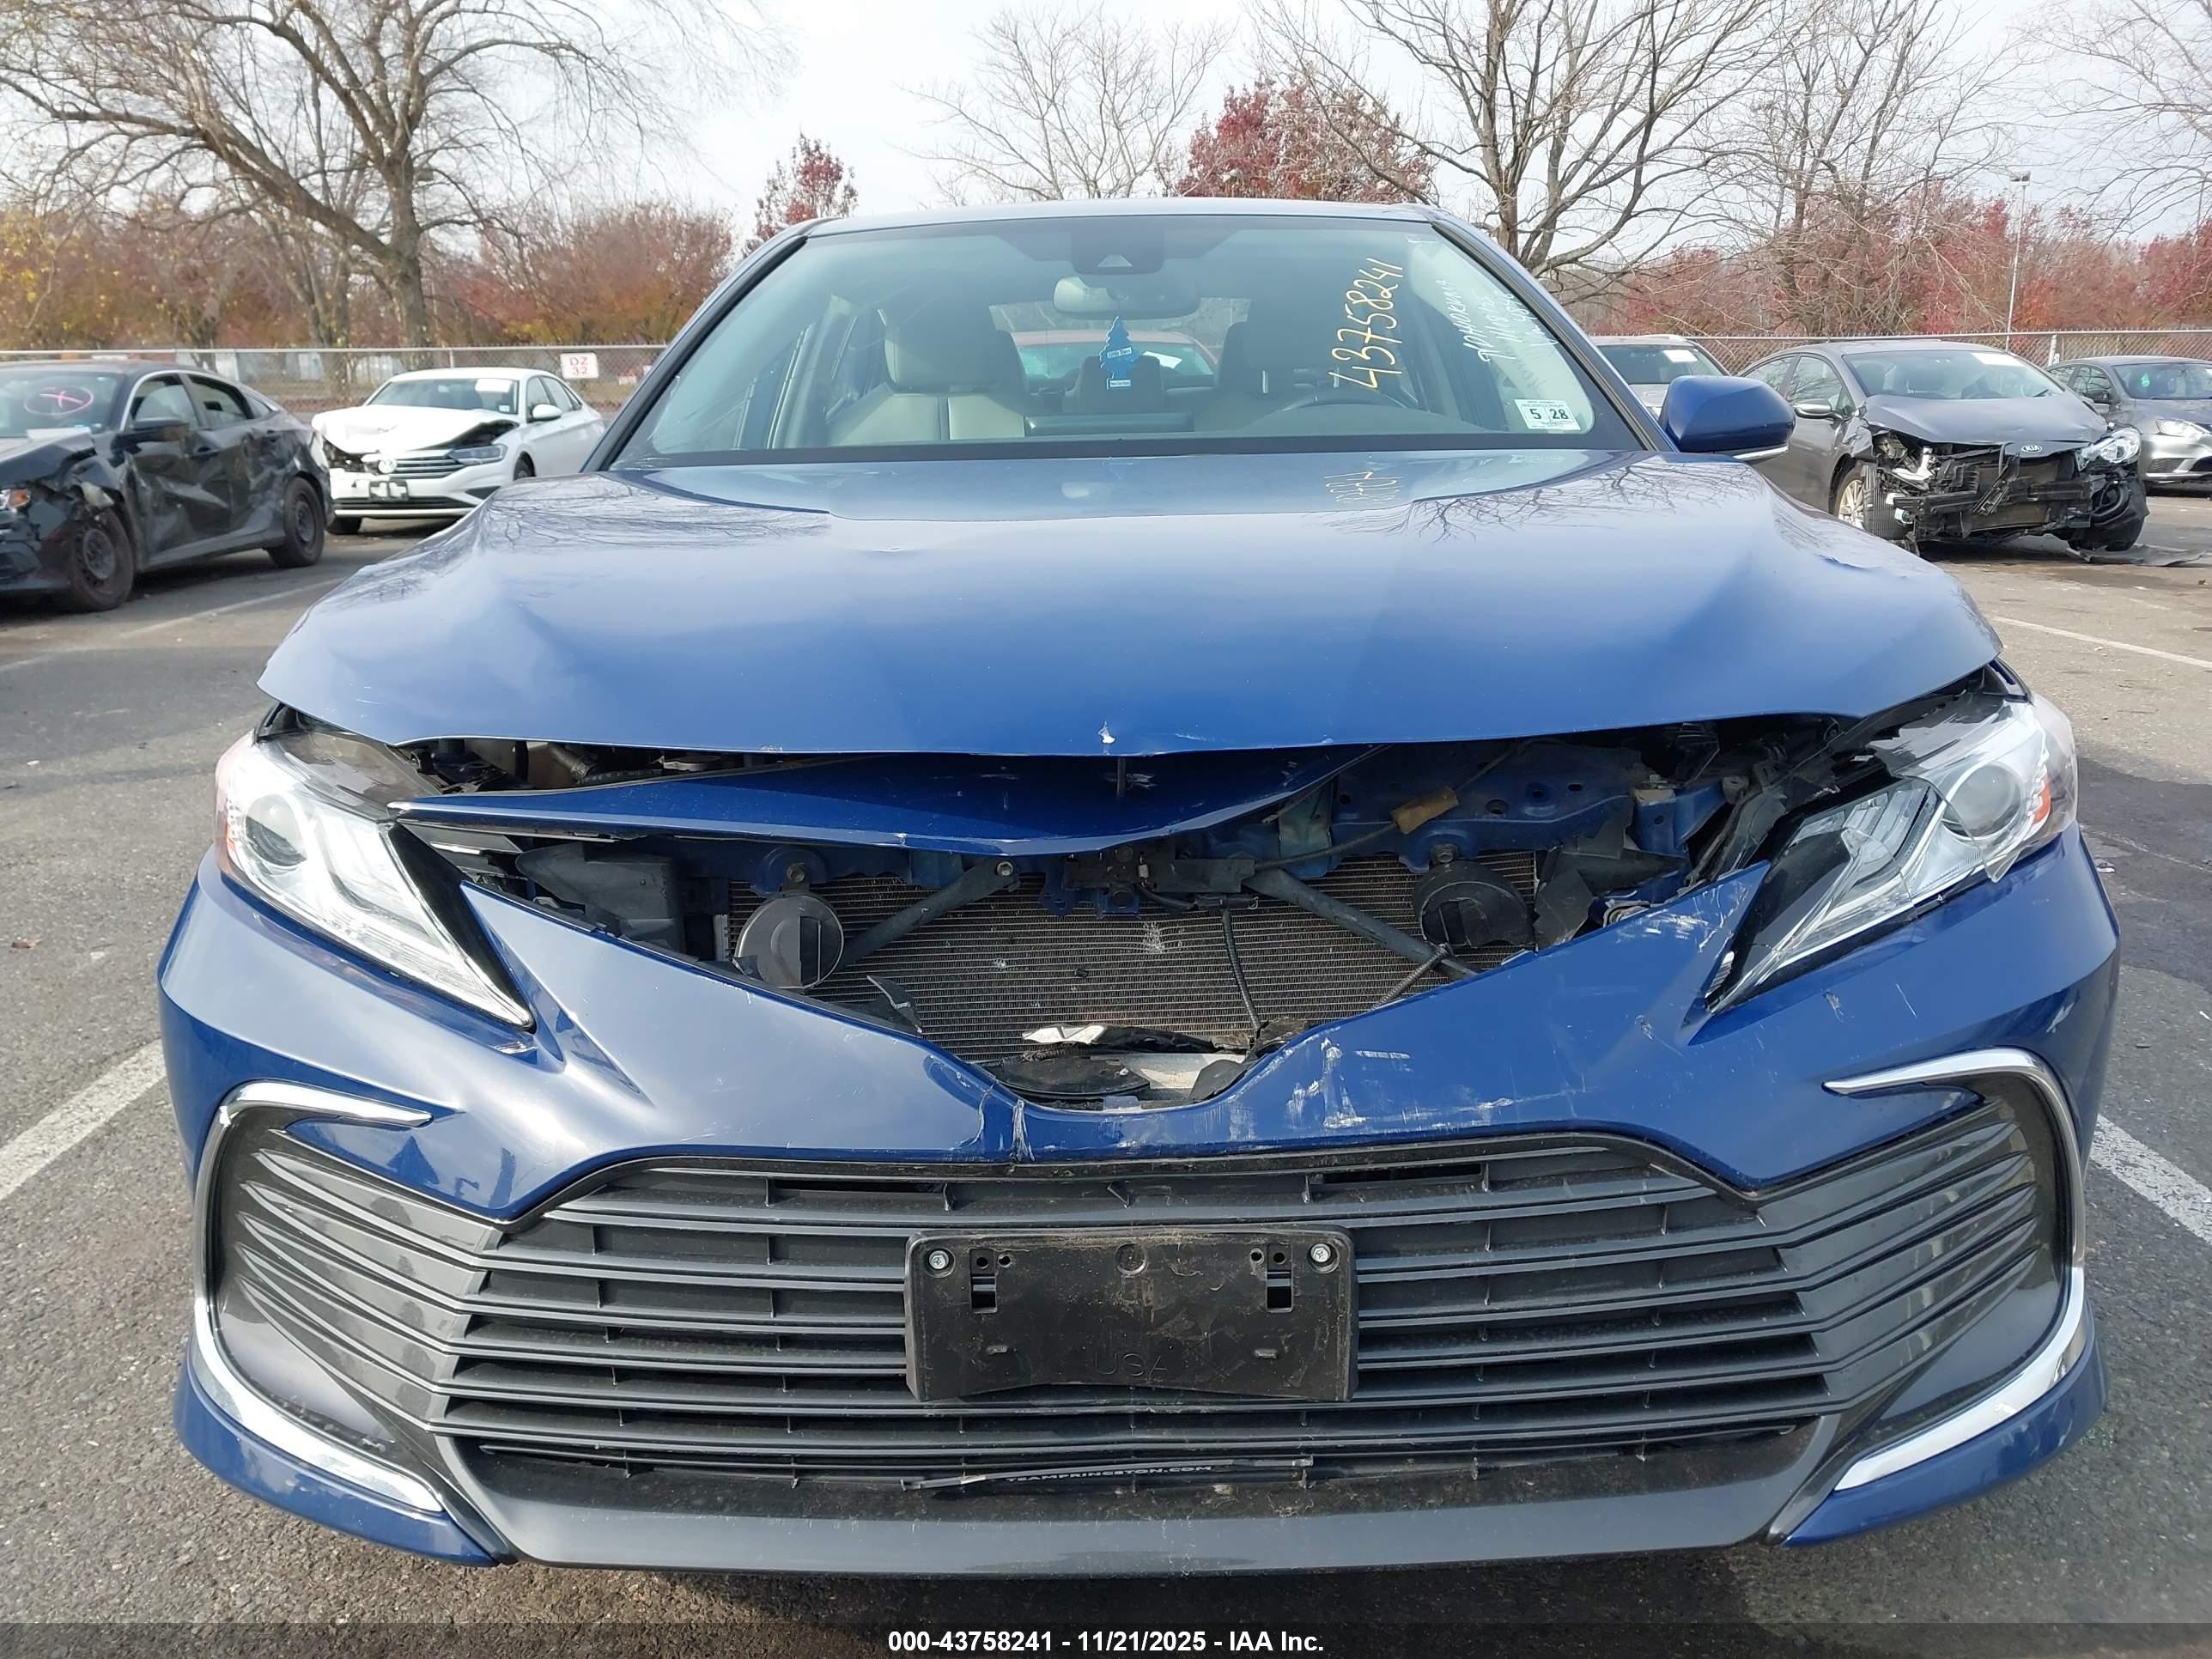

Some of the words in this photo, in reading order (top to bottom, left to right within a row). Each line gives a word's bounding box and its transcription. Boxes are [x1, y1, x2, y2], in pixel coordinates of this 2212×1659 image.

[1529, 408, 1542, 420] 5
[1548, 408, 1569, 420] 28
[1092, 1352, 1170, 1376] USA
[1006, 1465, 1213, 1483] TEAMPRINCETON.COM
